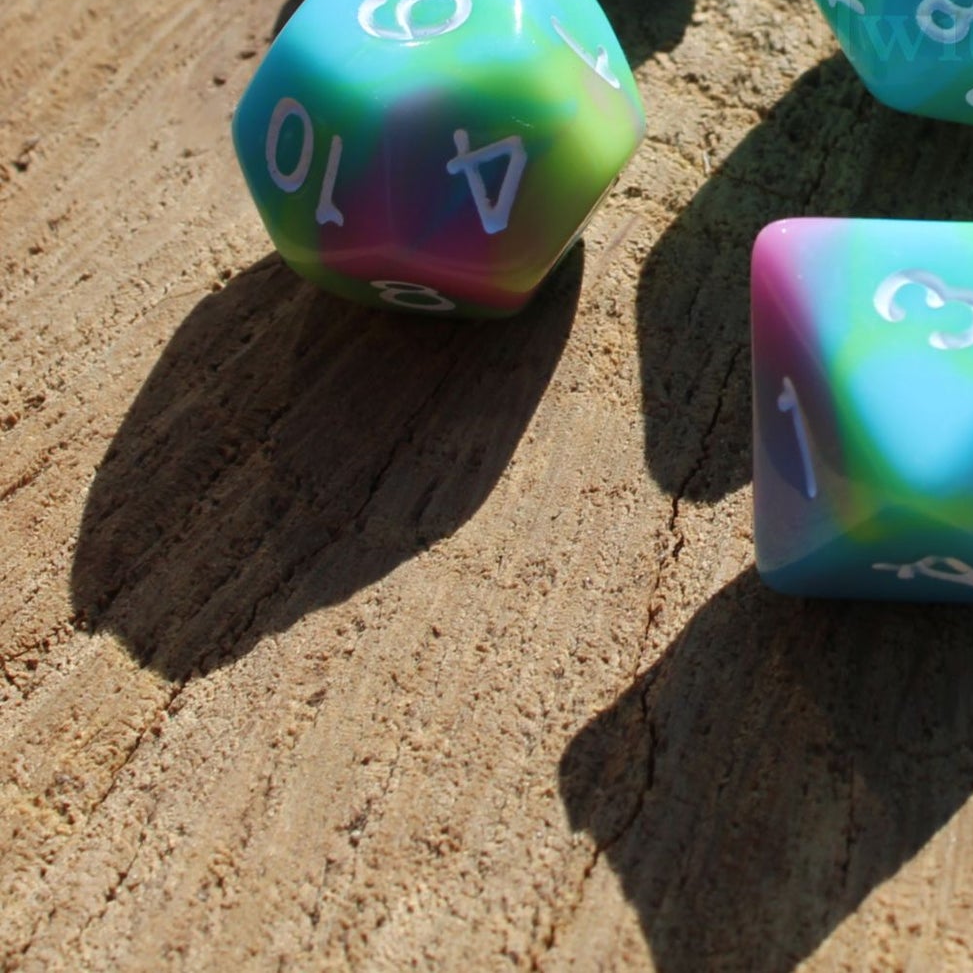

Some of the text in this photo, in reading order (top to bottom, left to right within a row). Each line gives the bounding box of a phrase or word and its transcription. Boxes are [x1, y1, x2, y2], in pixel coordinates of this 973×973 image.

[265, 97, 344, 226] 10
[447, 129, 527, 234] 4
[370, 281, 456, 310] 8
[777, 376, 815, 499] 1
